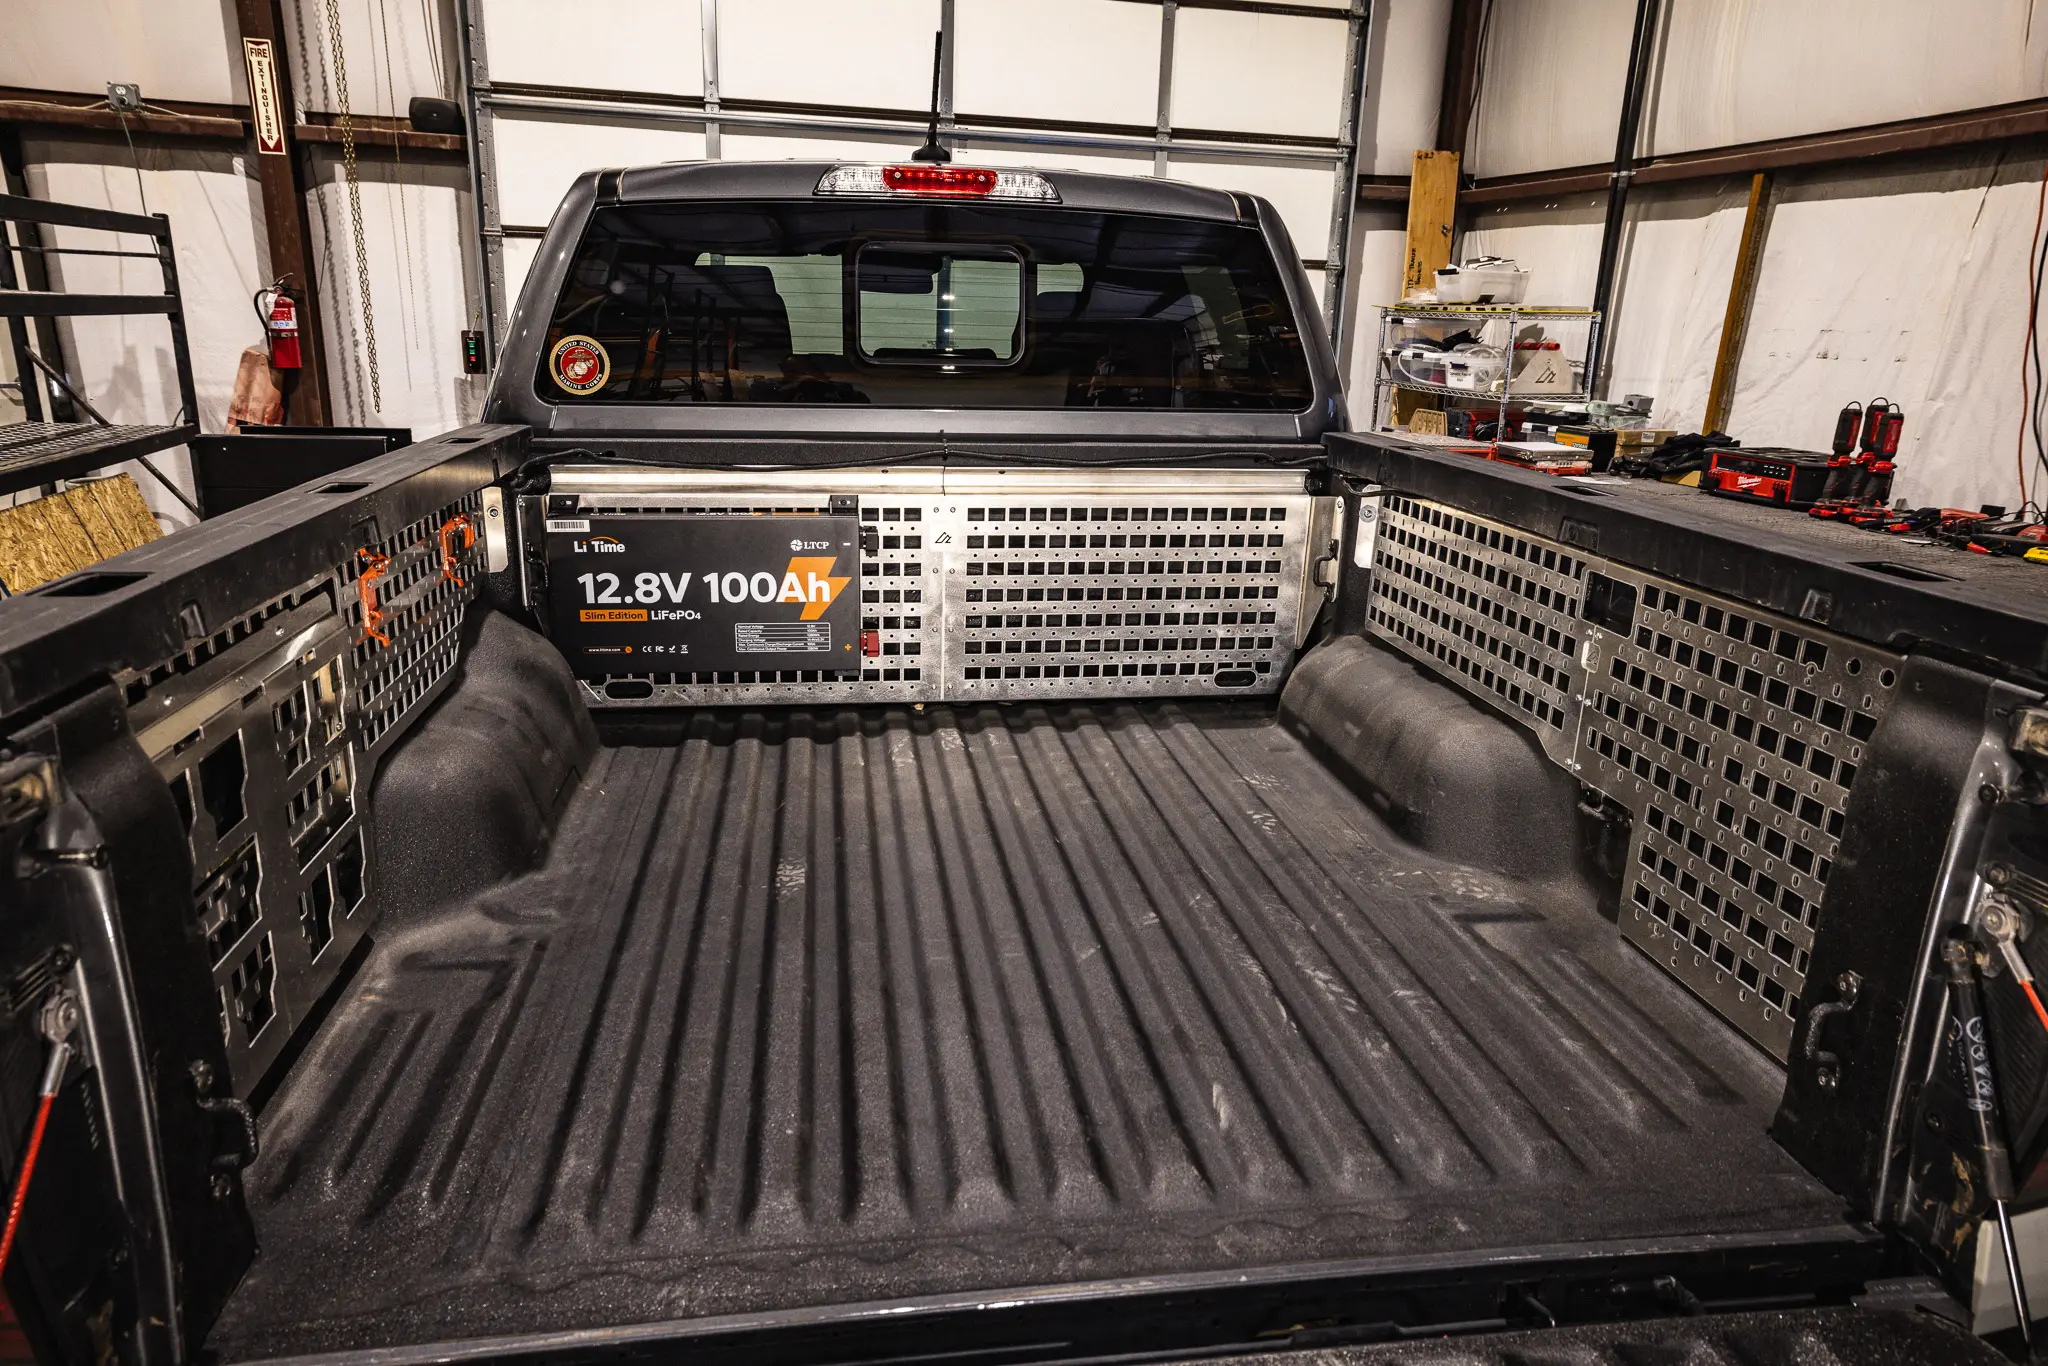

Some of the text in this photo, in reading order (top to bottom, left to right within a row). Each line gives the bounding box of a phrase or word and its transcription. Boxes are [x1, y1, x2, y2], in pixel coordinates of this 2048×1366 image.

[249, 47, 268, 58] FIRE
[257, 60, 274, 141] EXTINGUISHER
[557, 341, 600, 355] UNITED STATES
[558, 373, 603, 389] MARINE CORPS
[573, 540, 626, 553] Li Time
[803, 541, 830, 550] LTCP
[576, 571, 831, 604] 12.8V 100Ah
[584, 611, 644, 620] Slim Edition
[650, 610, 702, 621] LiFePO4
